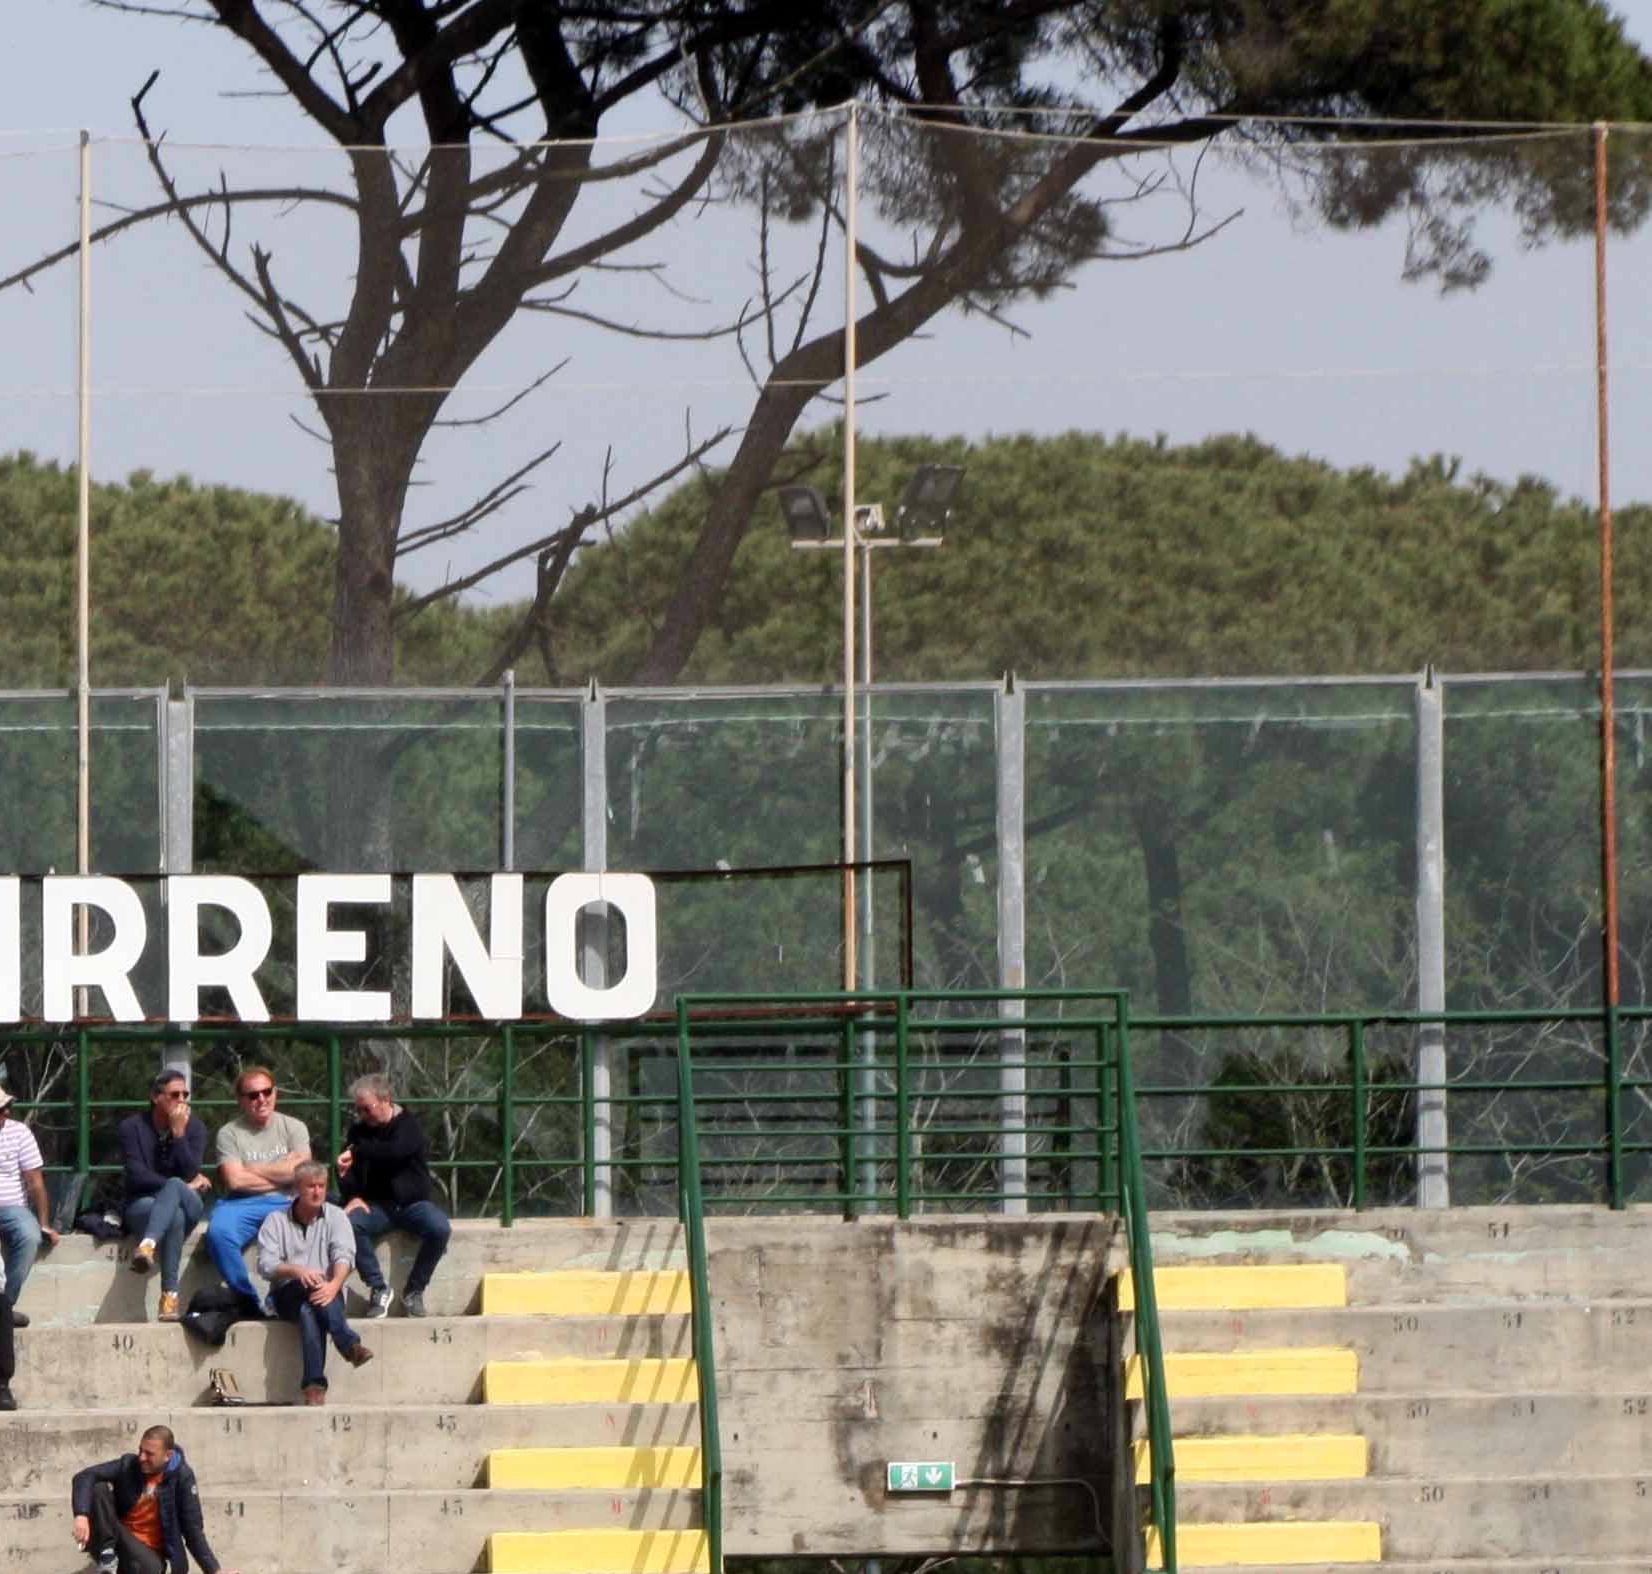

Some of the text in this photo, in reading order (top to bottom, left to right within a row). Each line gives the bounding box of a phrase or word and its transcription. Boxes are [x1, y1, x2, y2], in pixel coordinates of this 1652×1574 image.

[1394, 1316, 1418, 1333] 50
[112, 1334, 134, 1351] 40
[1407, 1402, 1430, 1418] 50
[1624, 1399, 1647, 1415] 52
[329, 1416, 352, 1432] 42
[1421, 1486, 1444, 1502] 50
[225, 1502, 245, 1518] 41
